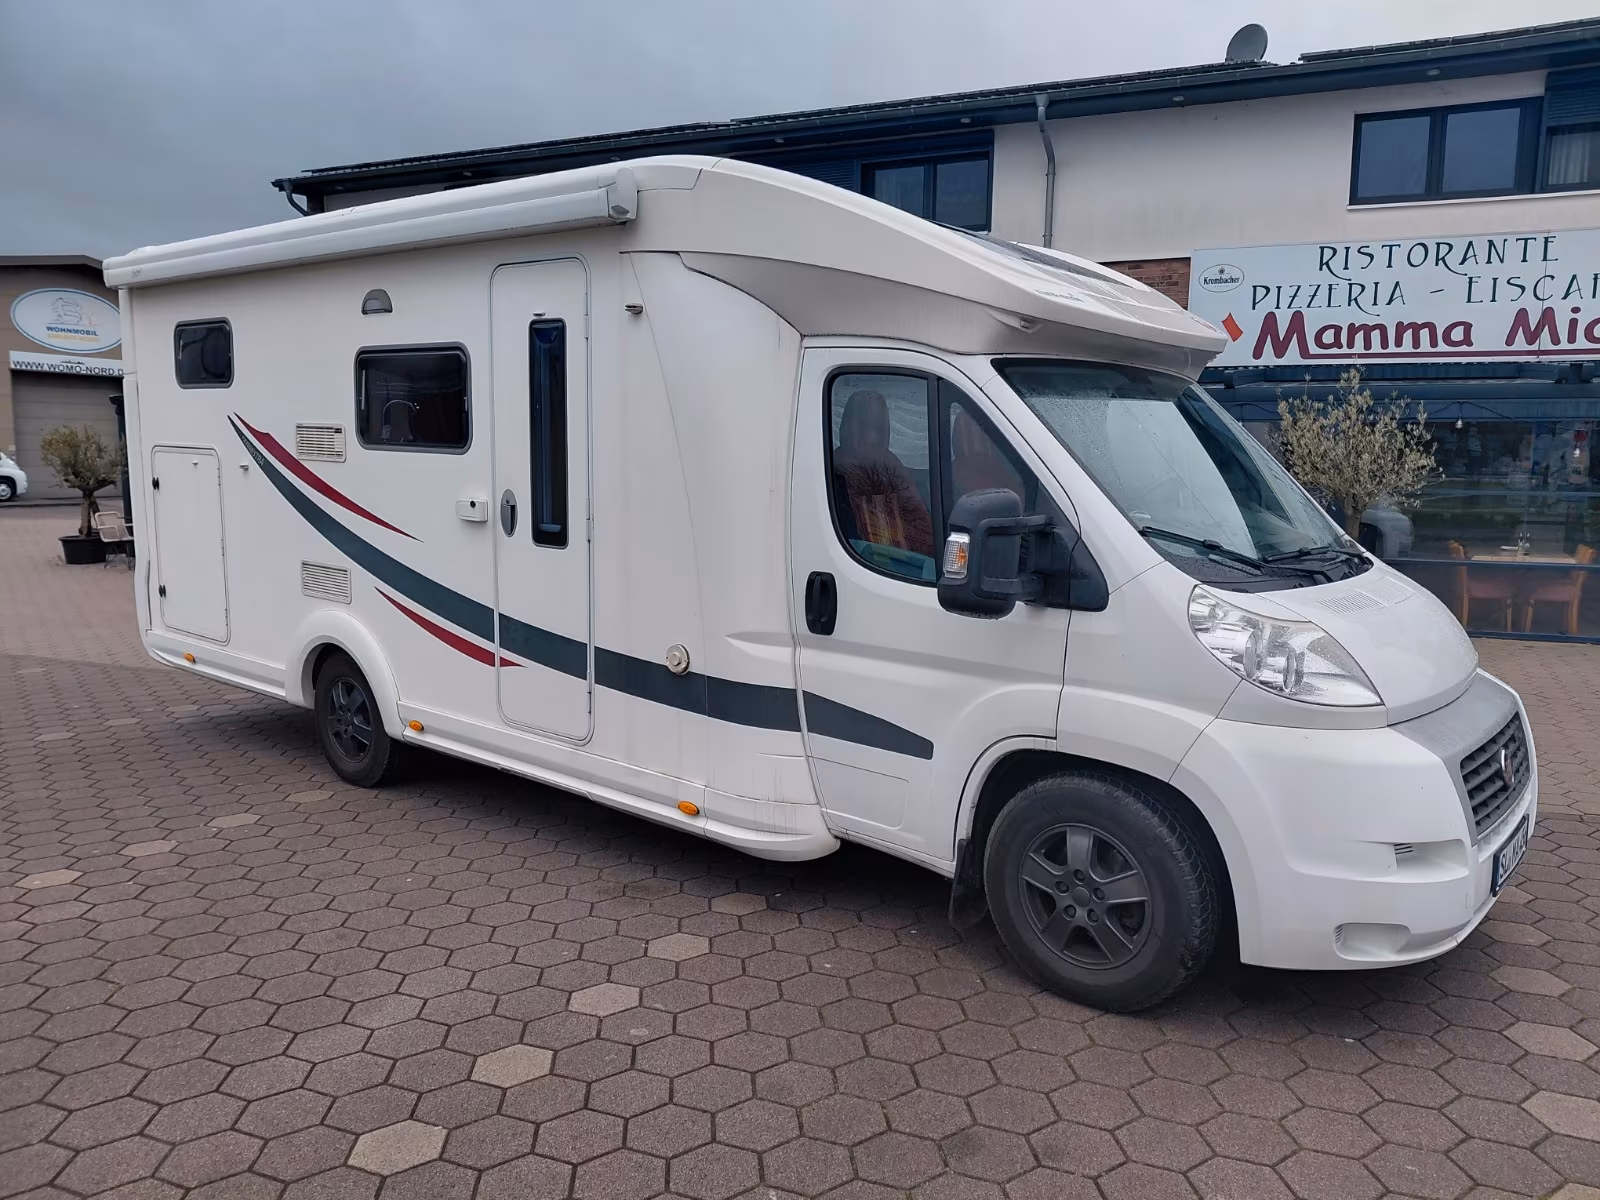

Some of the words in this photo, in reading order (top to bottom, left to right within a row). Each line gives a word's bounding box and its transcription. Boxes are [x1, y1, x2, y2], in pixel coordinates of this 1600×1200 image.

[1318, 235, 1560, 282] RISTORANTE
[1203, 275, 1240, 285] Krombacher
[1251, 280, 1407, 317] PIZZERIA
[46, 326, 99, 337] WOHNMOBIL
[1252, 309, 1474, 361] Mamma
